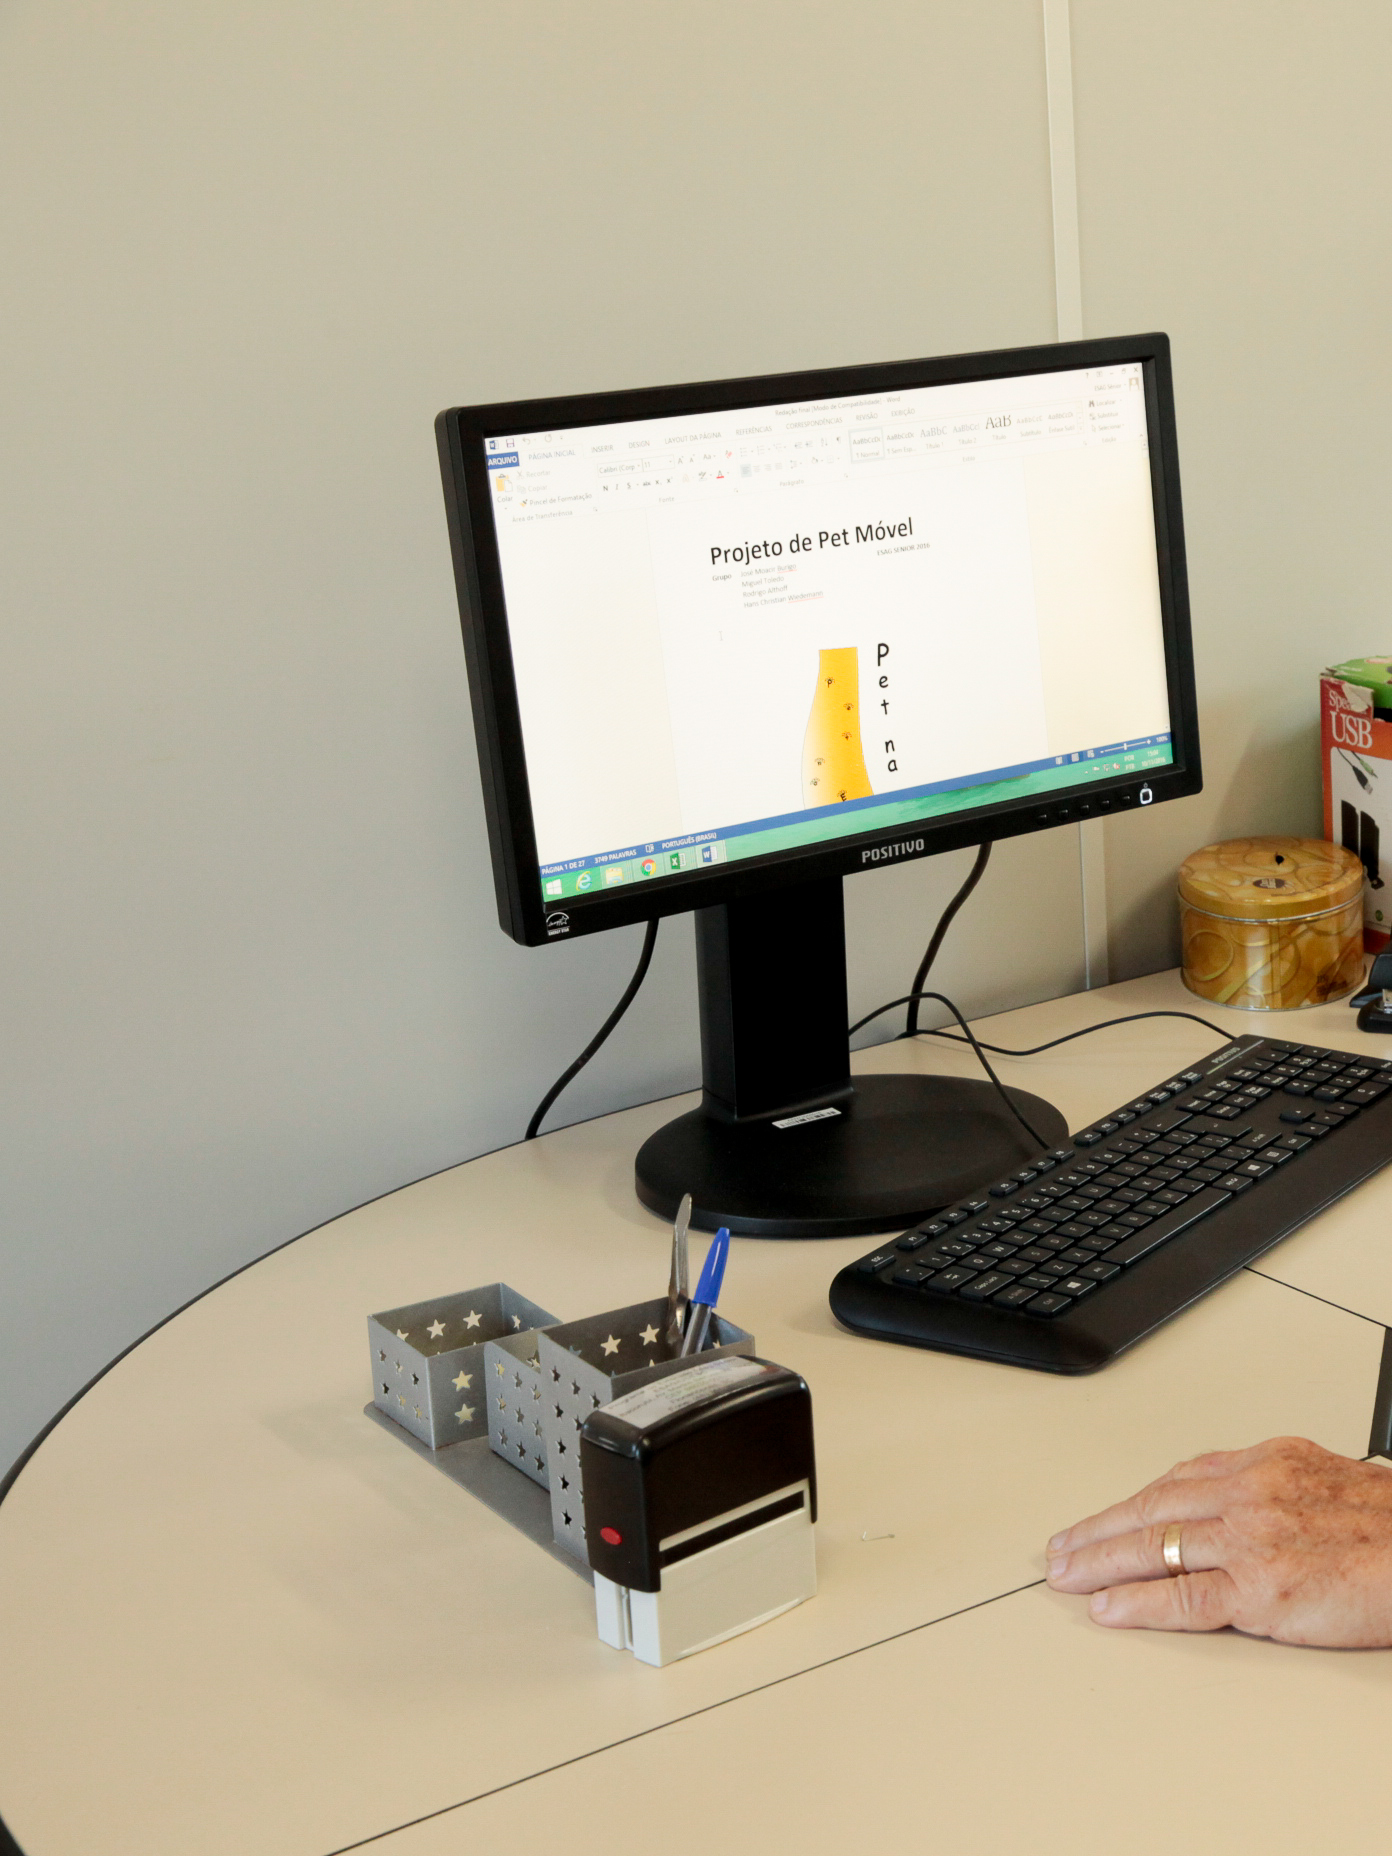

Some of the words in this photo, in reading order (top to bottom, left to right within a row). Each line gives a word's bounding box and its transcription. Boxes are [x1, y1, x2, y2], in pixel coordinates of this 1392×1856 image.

[856, 411, 878, 421] REVISÃO
[786, 416, 843, 430] CORRESPONDÊNCIAS
[735, 425, 772, 436] REFERÊNCIAS
[665, 435, 688, 444] LAYOUT
[699, 431, 722, 441] PÁGINA
[591, 444, 614, 453] INSERIR
[628, 440, 650, 449] DESIGN
[488, 455, 518, 467] ARQUIVO
[528, 451, 553, 461] PÁGINA
[553, 449, 576, 459] INICIAL
[599, 465, 618, 474] Calibri
[497, 495, 513, 503] Colar
[710, 539, 783, 566] Projeto
[789, 533, 813, 554] de
[818, 527, 850, 549] Pet
[855, 516, 914, 544] Móvel
[877, 548, 893, 556] ESAG
[893, 544, 916, 554] SENIOR
[916, 542, 931, 551] 2016
[712, 573, 732, 582] Grupo
[740, 568, 754, 578] José
[754, 566, 776, 575] Moacir
[741, 578, 763, 588] Miguel
[763, 575, 784, 584] Toledo
[742, 589, 767, 599] Rodrigo
[767, 584, 788, 594] Althoff
[743, 600, 759, 609] Hans
[760, 595, 787, 606] Christian
[788, 590, 824, 602] Wiedemann
[1329, 710, 1373, 749] USB
[662, 836, 695, 850] PORTUGUÊS
[695, 832, 717, 844] (BRASIL)
[608, 850, 637, 862] PALAVRAS
[861, 838, 925, 863] POSITIVO
[541, 864, 564, 876] PÁGINA
[569, 861, 578, 869] DE
[578, 860, 585, 868] 27
